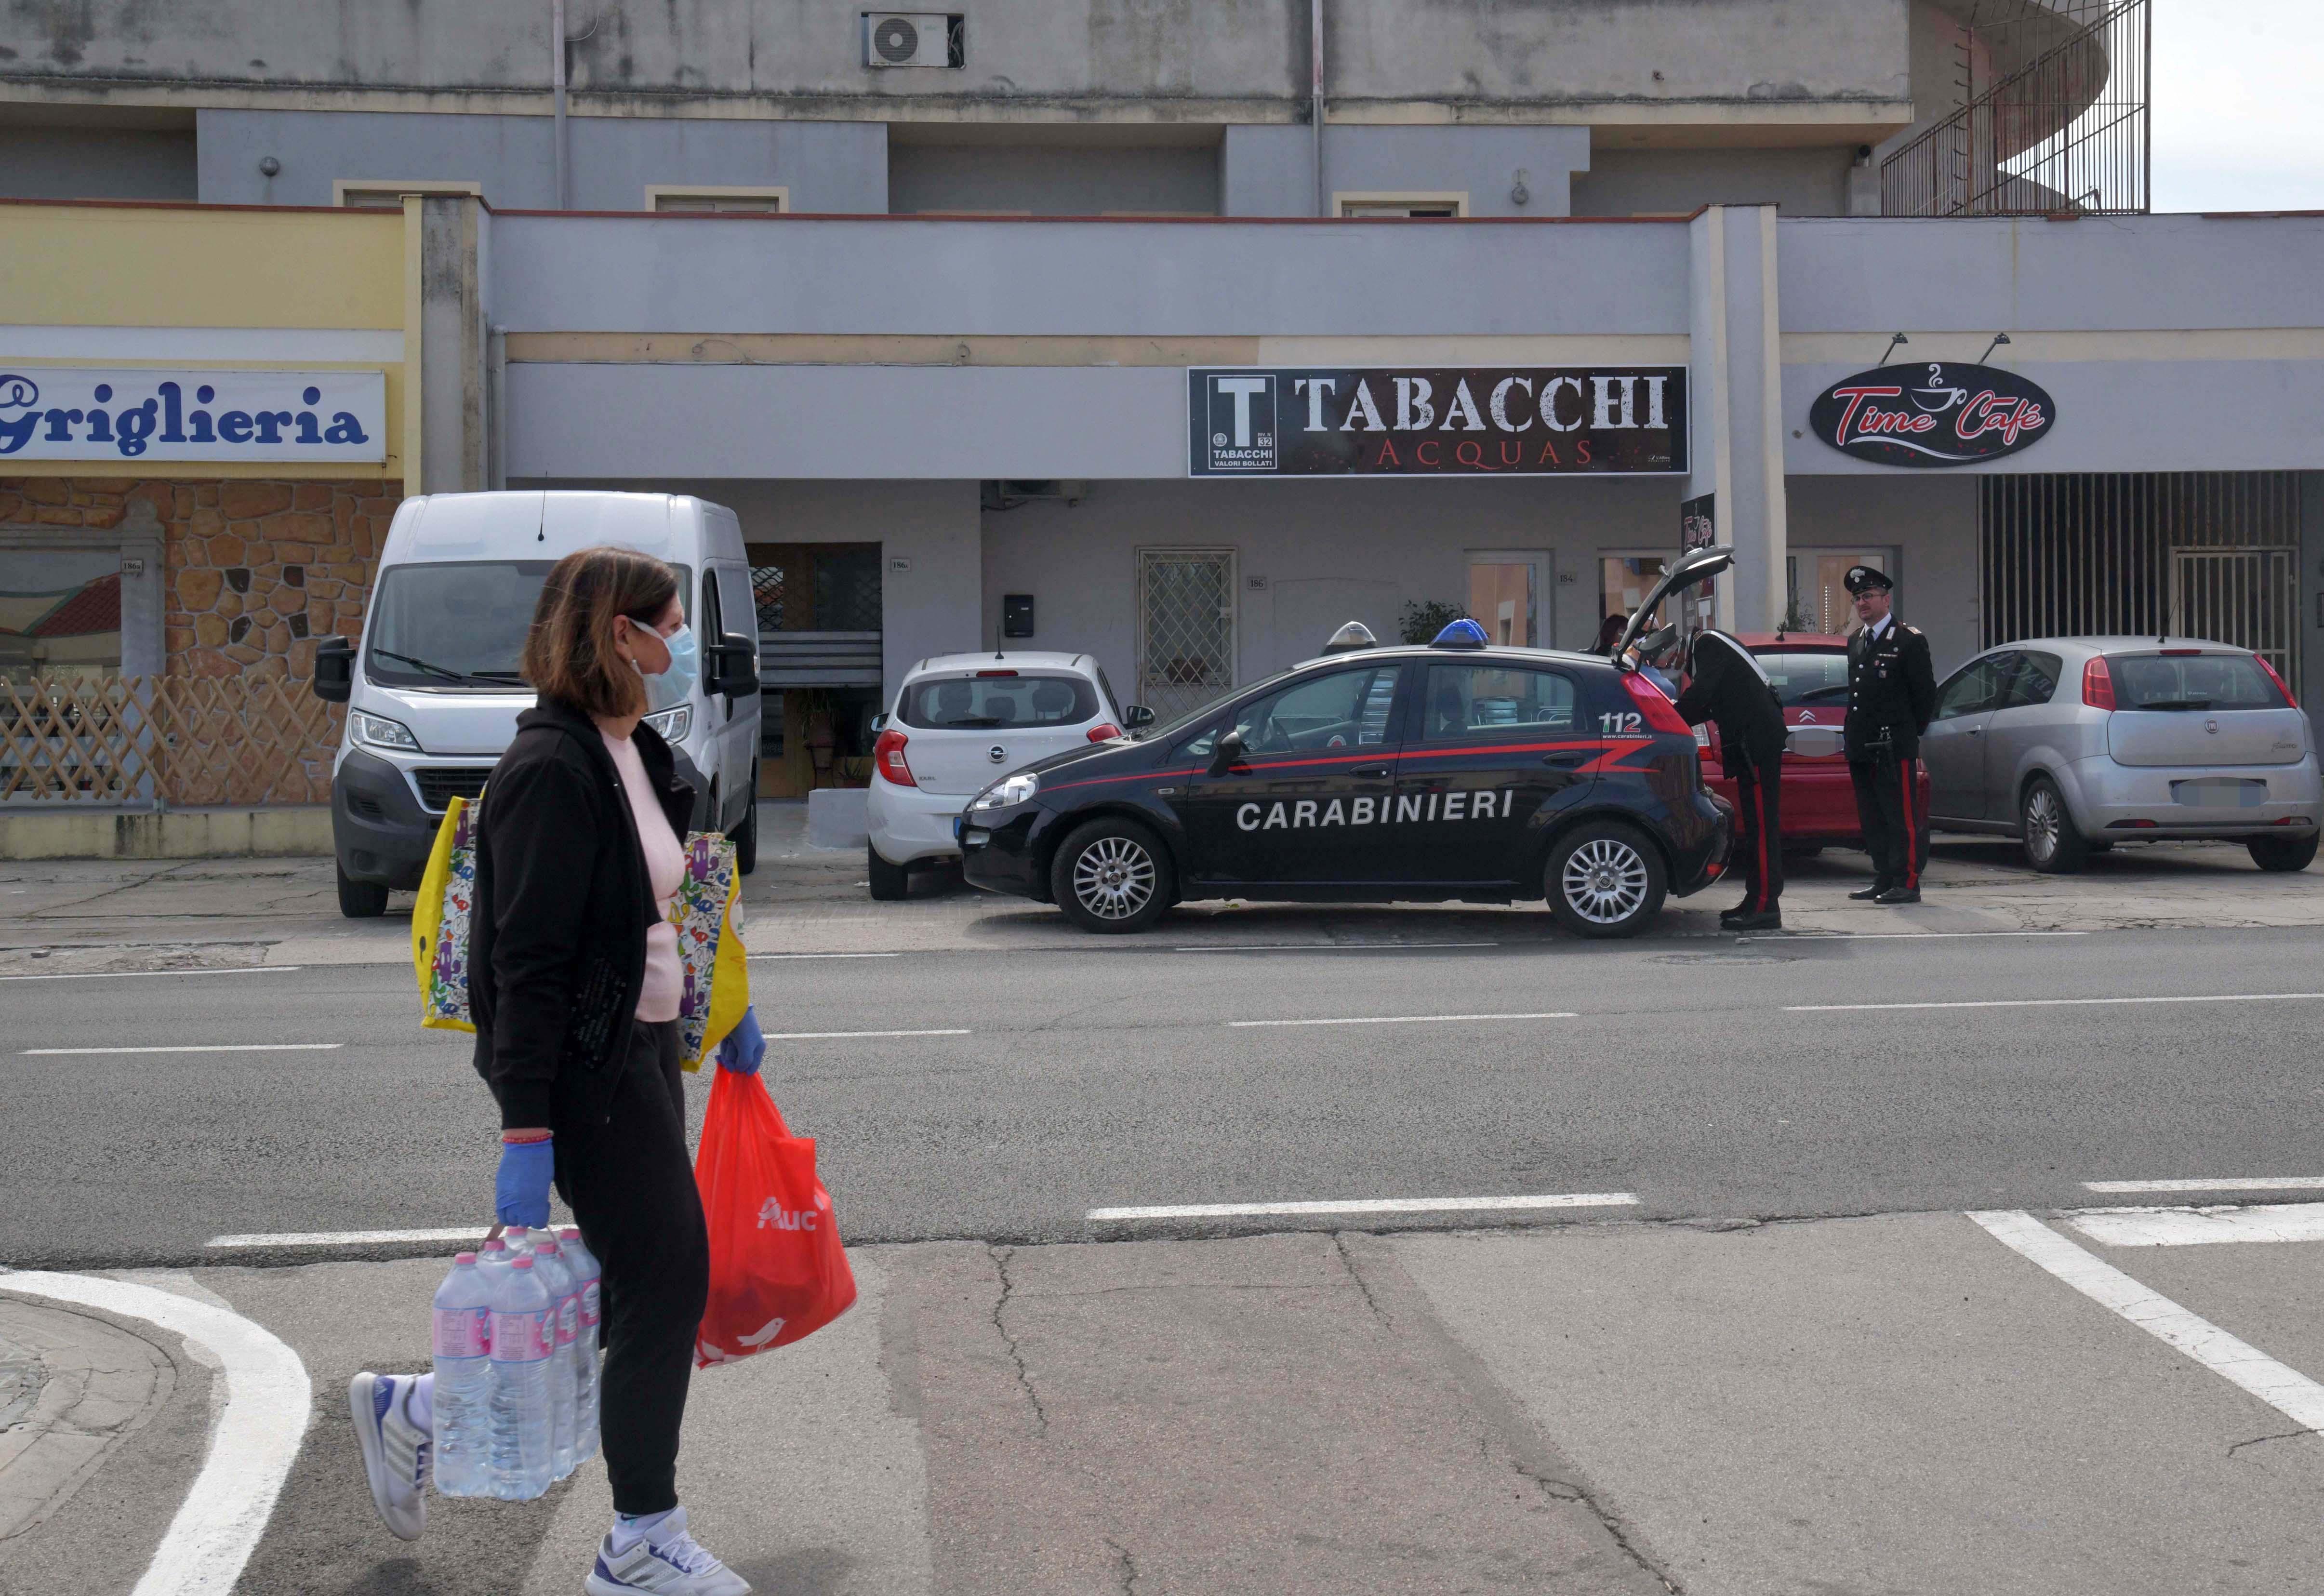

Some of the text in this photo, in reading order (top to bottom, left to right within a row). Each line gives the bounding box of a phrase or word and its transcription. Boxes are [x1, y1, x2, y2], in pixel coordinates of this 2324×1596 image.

[0, 374, 369, 456] Griglieria
[1218, 378, 1265, 446] T
[1295, 376, 1669, 432] TABACCHI
[1833, 386, 2045, 446] Time Café
[1213, 450, 1273, 458] TABACCHI
[1377, 438, 1592, 470] ACQUAS
[1599, 712, 1642, 732] 112
[1236, 790, 1513, 831] CARABINIERI
